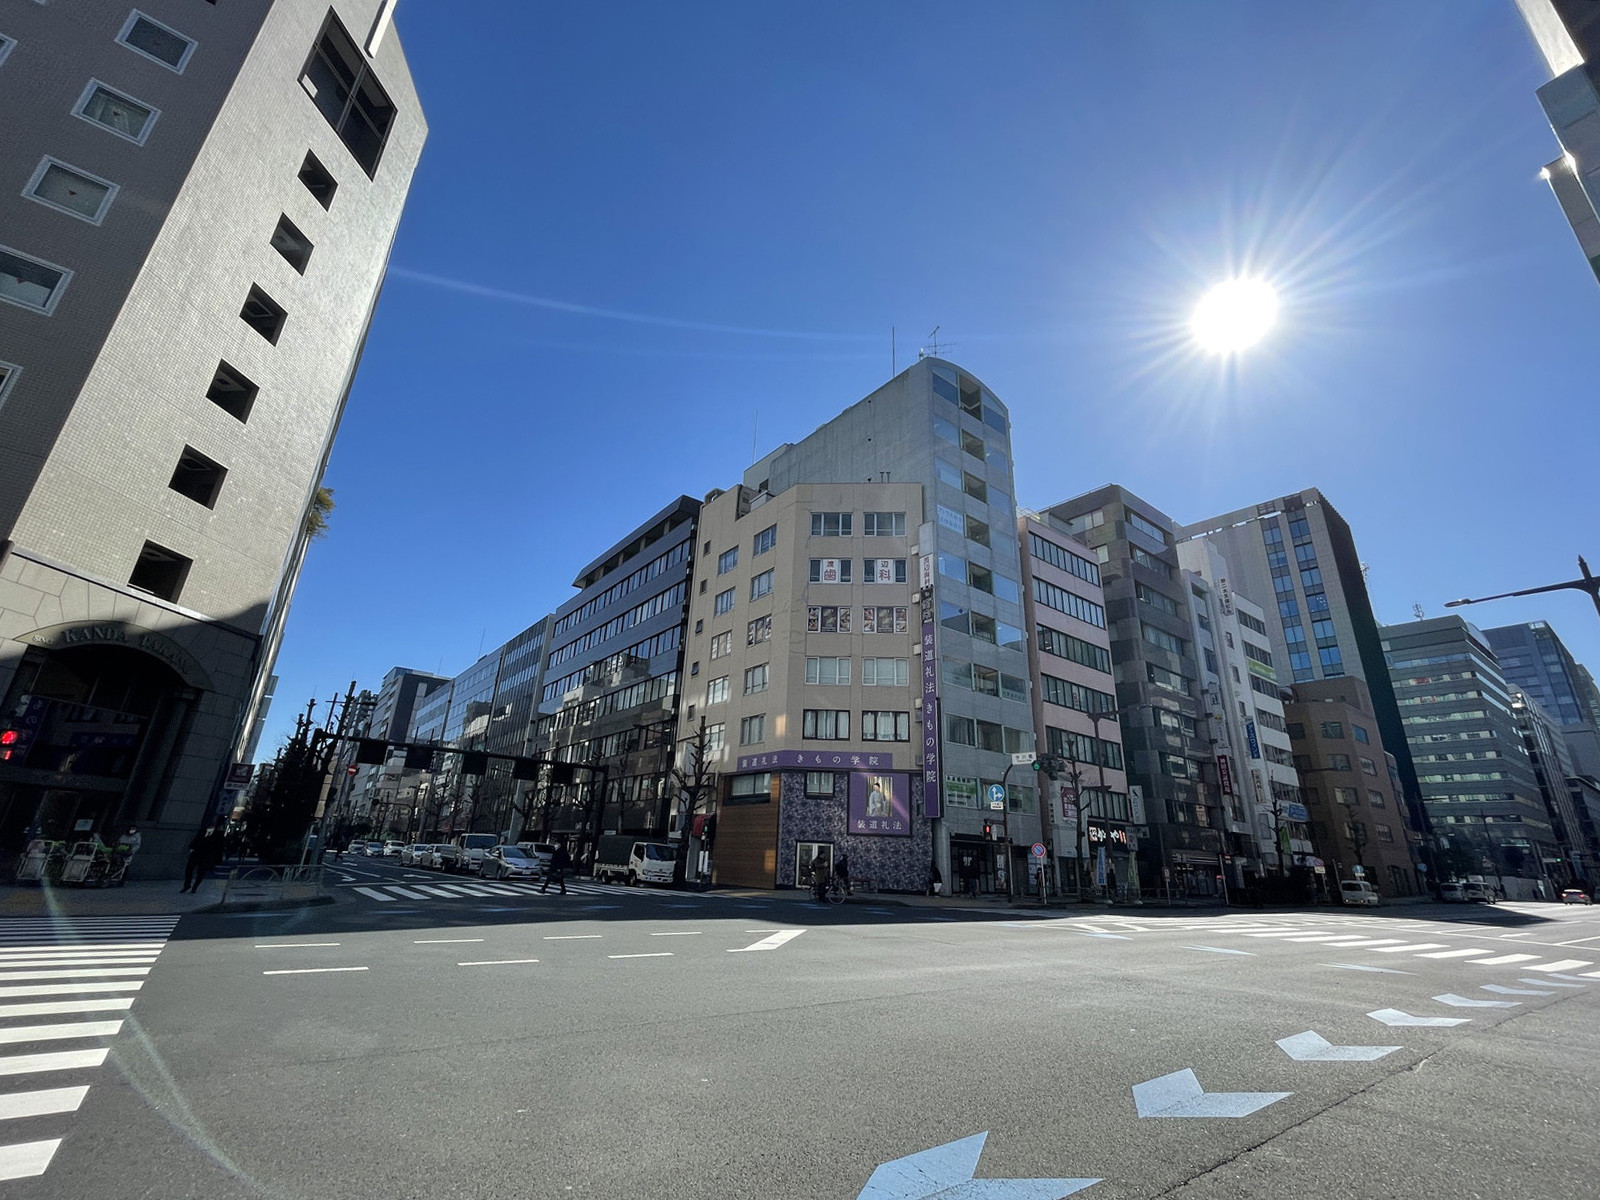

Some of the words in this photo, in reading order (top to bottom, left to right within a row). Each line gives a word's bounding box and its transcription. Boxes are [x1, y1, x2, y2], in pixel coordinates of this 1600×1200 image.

[63, 627, 128, 643] KANDA
[857, 819, 902, 830] 装道礼法
